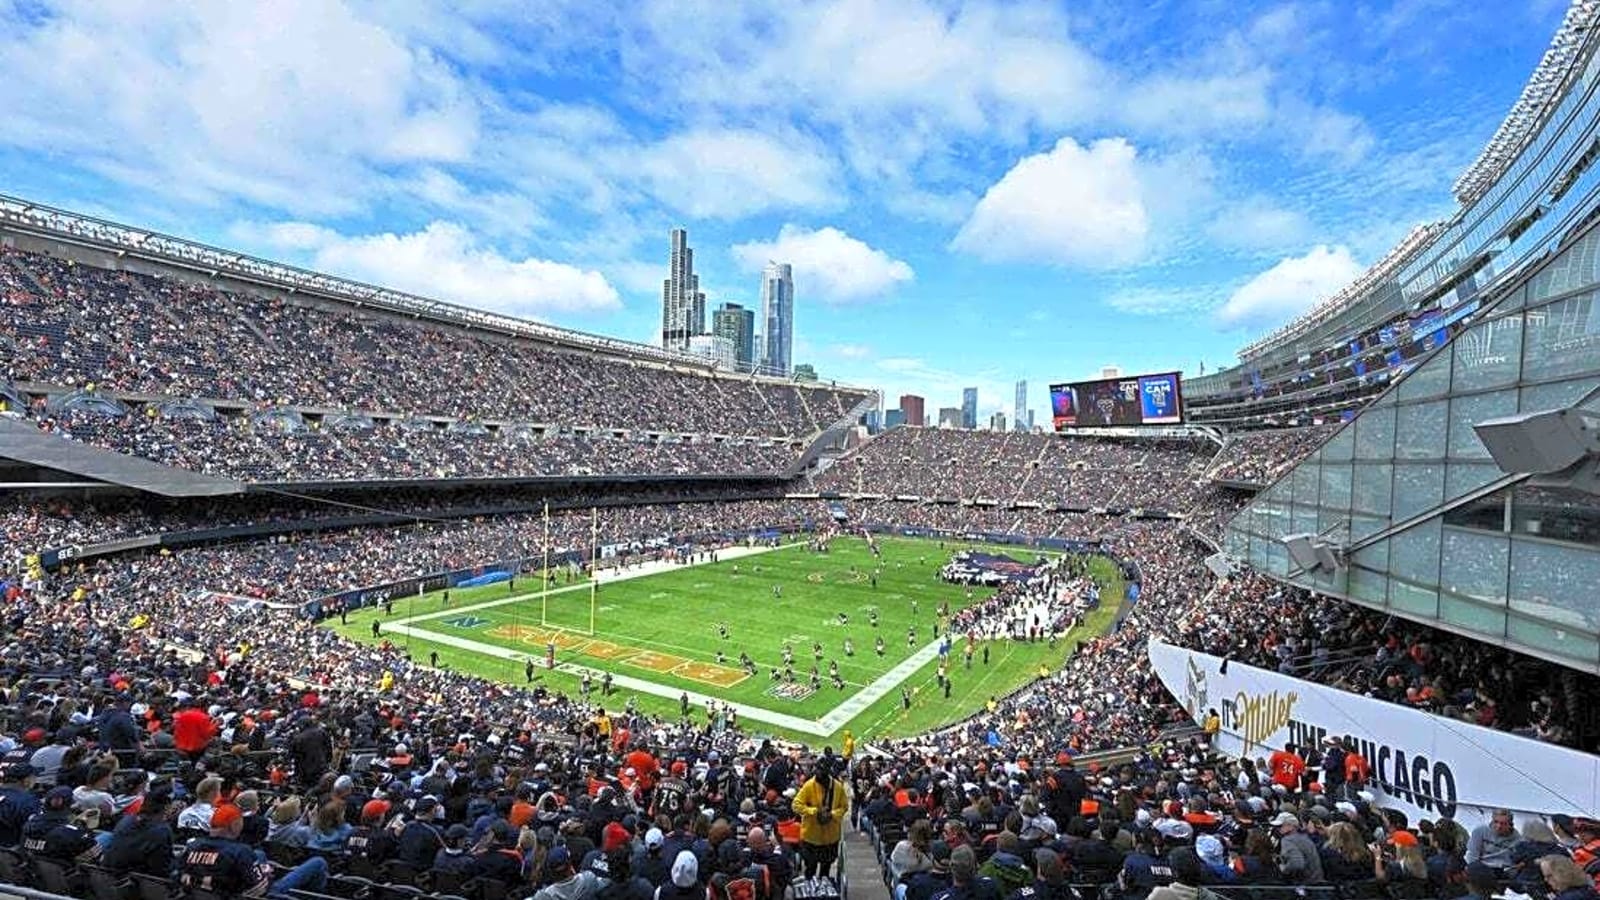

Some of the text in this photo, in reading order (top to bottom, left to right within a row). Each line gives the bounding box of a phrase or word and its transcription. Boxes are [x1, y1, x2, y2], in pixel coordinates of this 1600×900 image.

[1145, 384, 1171, 393] CAM
[1235, 690, 1298, 757] Miller
[1282, 761, 1294, 774] 34
[659, 789, 678, 810] 76
